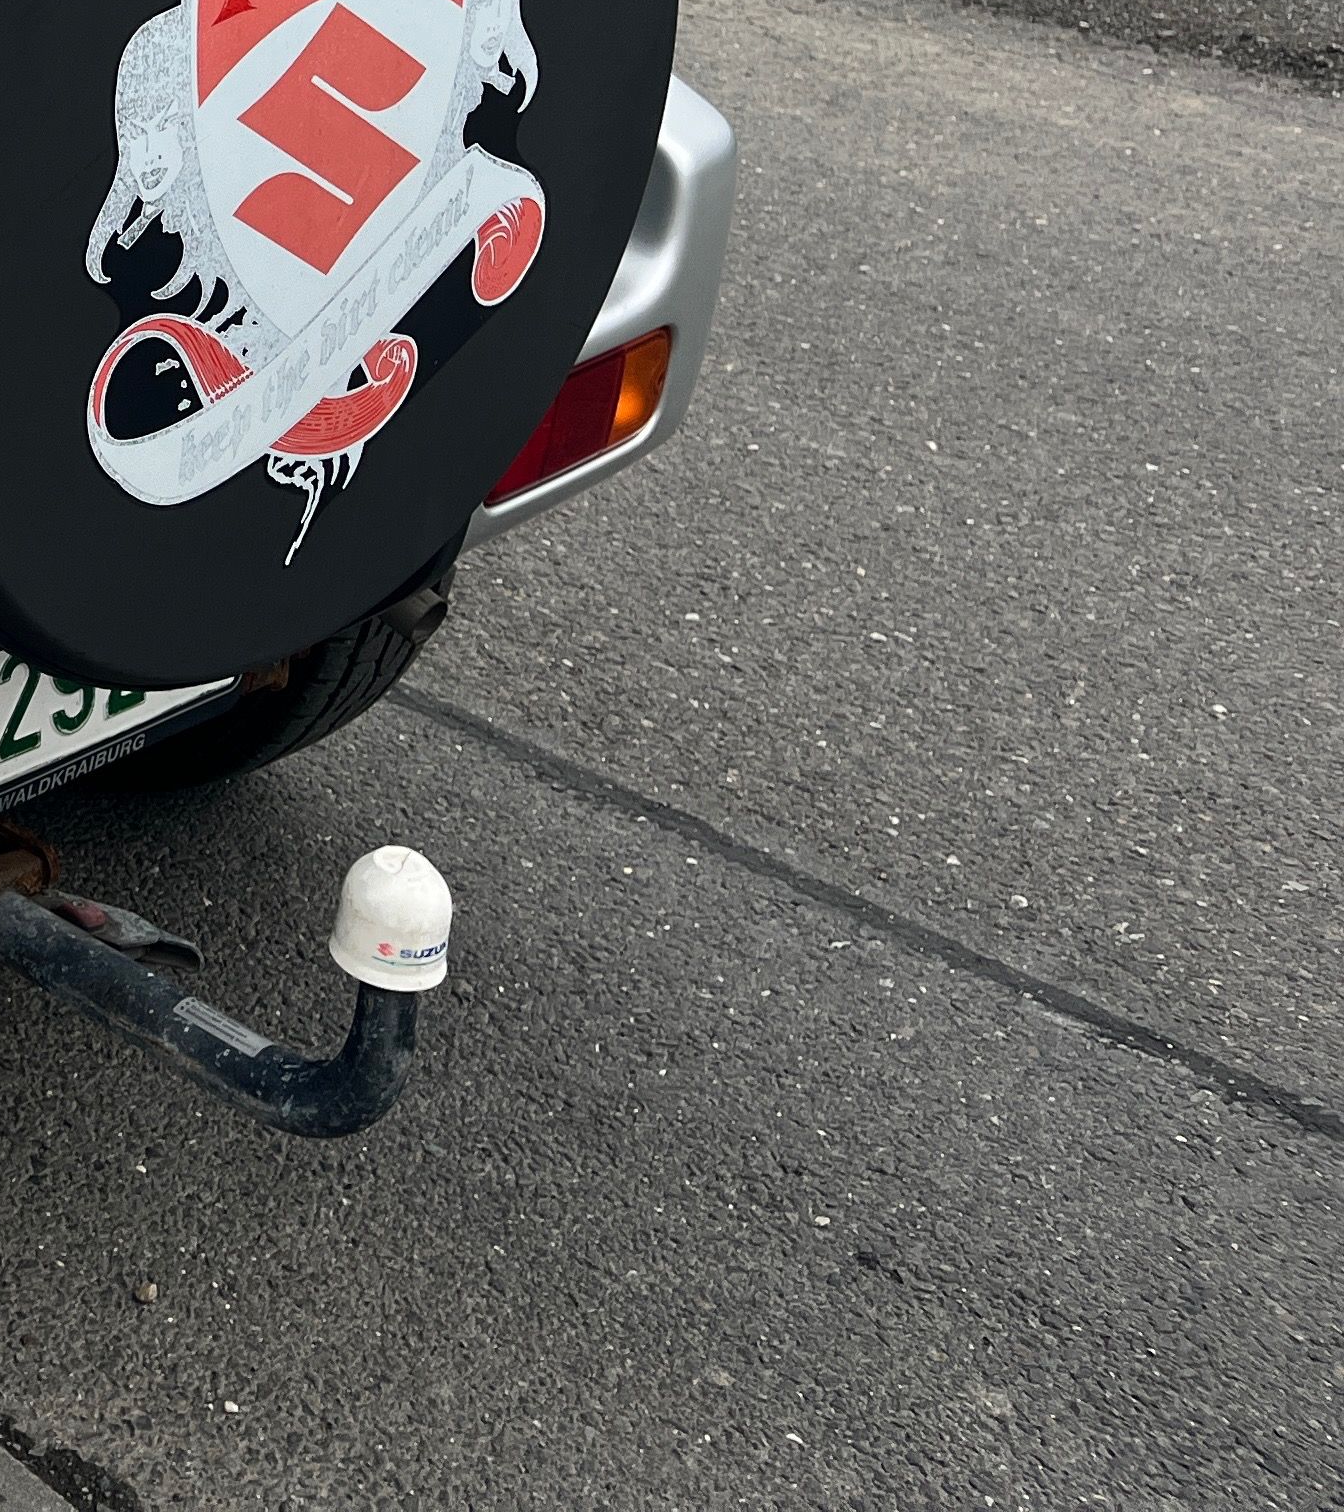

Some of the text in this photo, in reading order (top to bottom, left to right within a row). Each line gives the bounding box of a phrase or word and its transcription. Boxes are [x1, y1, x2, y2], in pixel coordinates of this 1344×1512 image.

[179, 166, 476, 487] keep the dirt clean!
